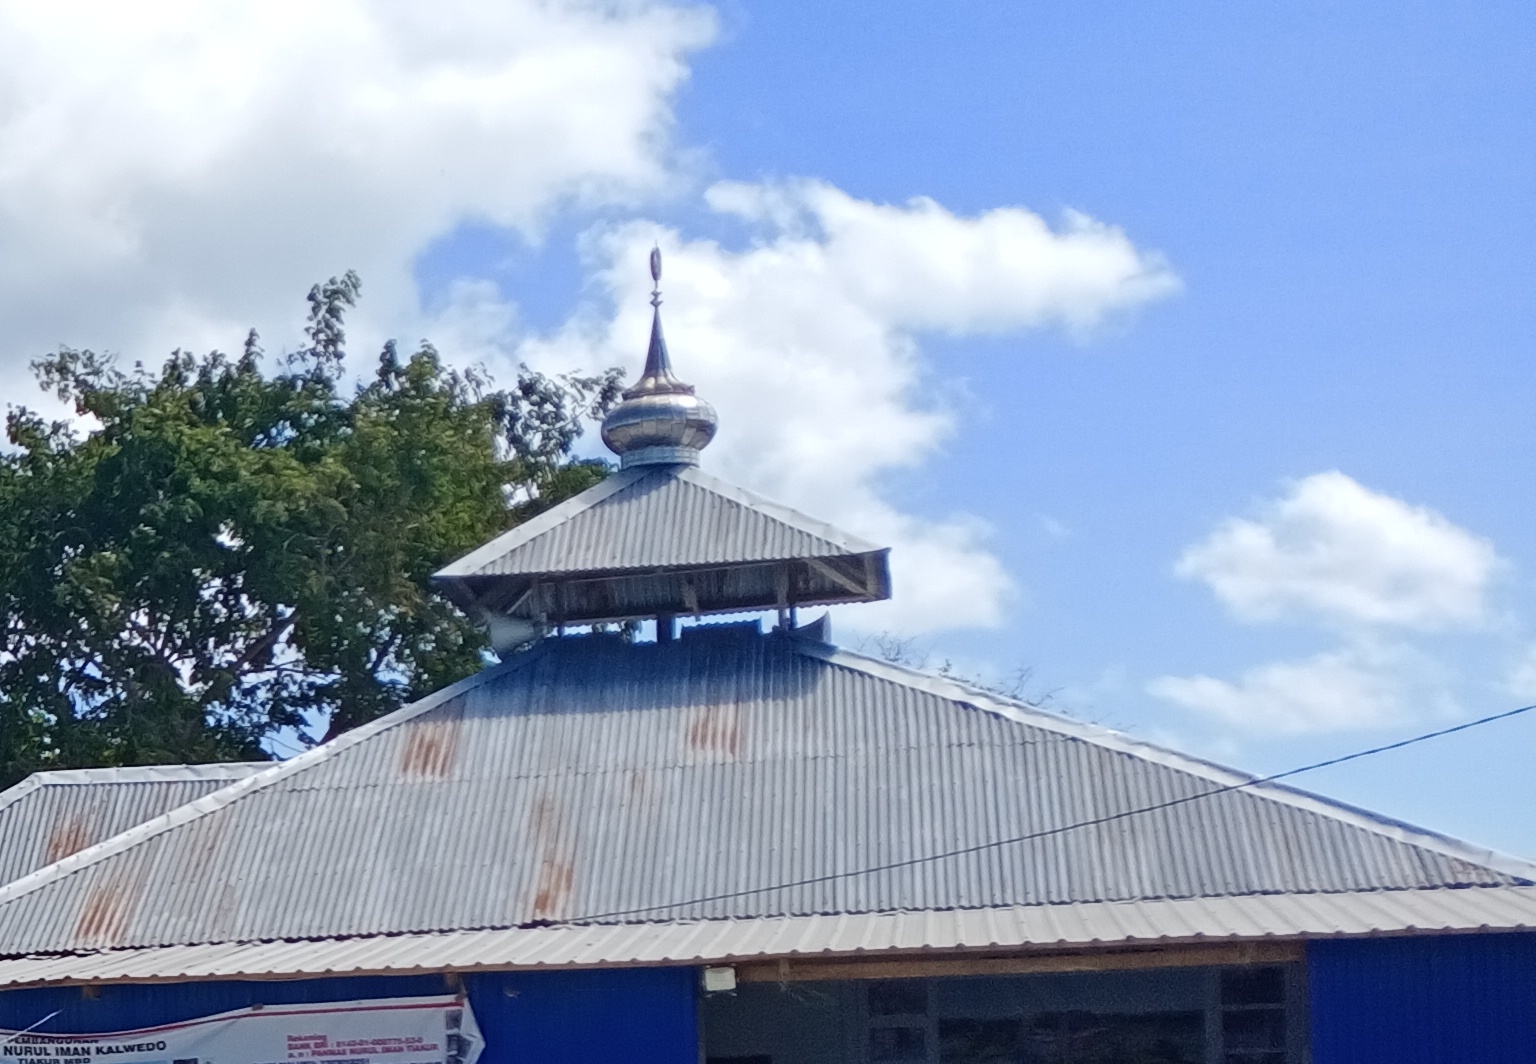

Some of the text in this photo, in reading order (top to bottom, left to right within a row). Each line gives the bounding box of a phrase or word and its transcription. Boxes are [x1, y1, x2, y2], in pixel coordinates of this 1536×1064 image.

[3, 1045, 52, 1057] NURUL
[54, 1046, 91, 1057] IMAN
[95, 1040, 167, 1056] KALWEDO
